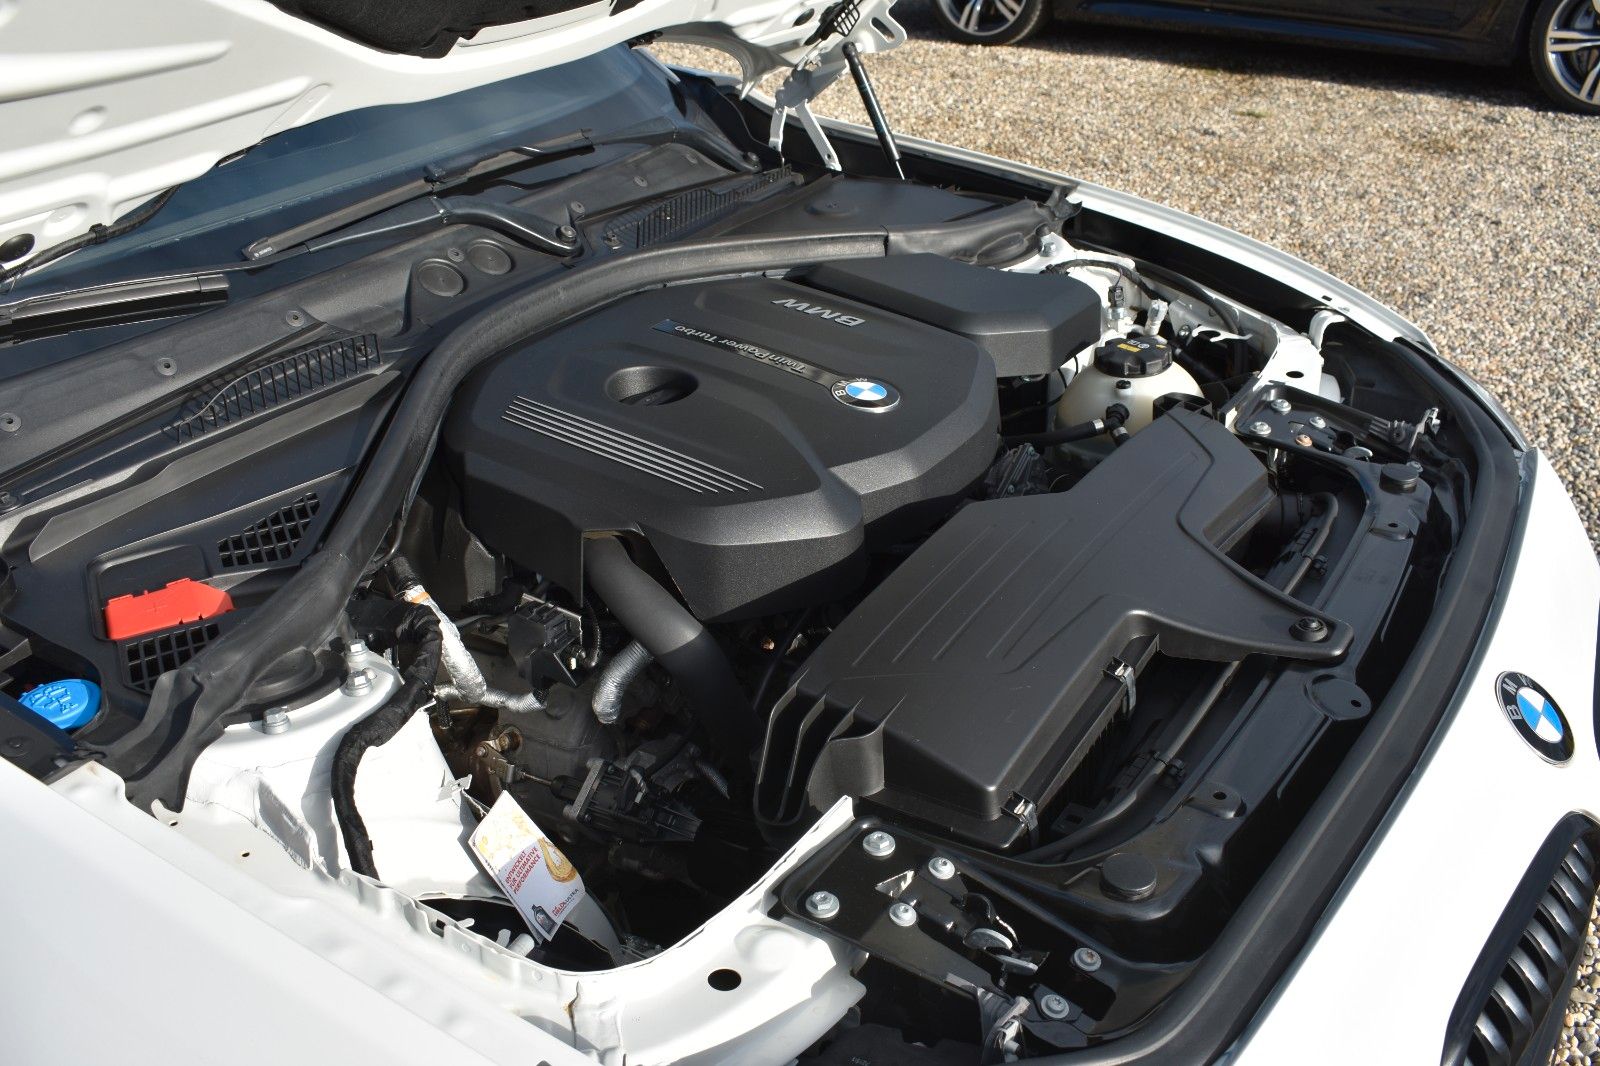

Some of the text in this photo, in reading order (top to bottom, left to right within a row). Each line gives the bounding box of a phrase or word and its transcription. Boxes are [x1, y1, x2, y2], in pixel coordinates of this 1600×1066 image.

[771, 298, 866, 328] BMW
[674, 324, 806, 374] TwinPower Turbo
[513, 854, 541, 894] PERFORMANCE
[515, 846, 538, 878] ULTIMATIVE
